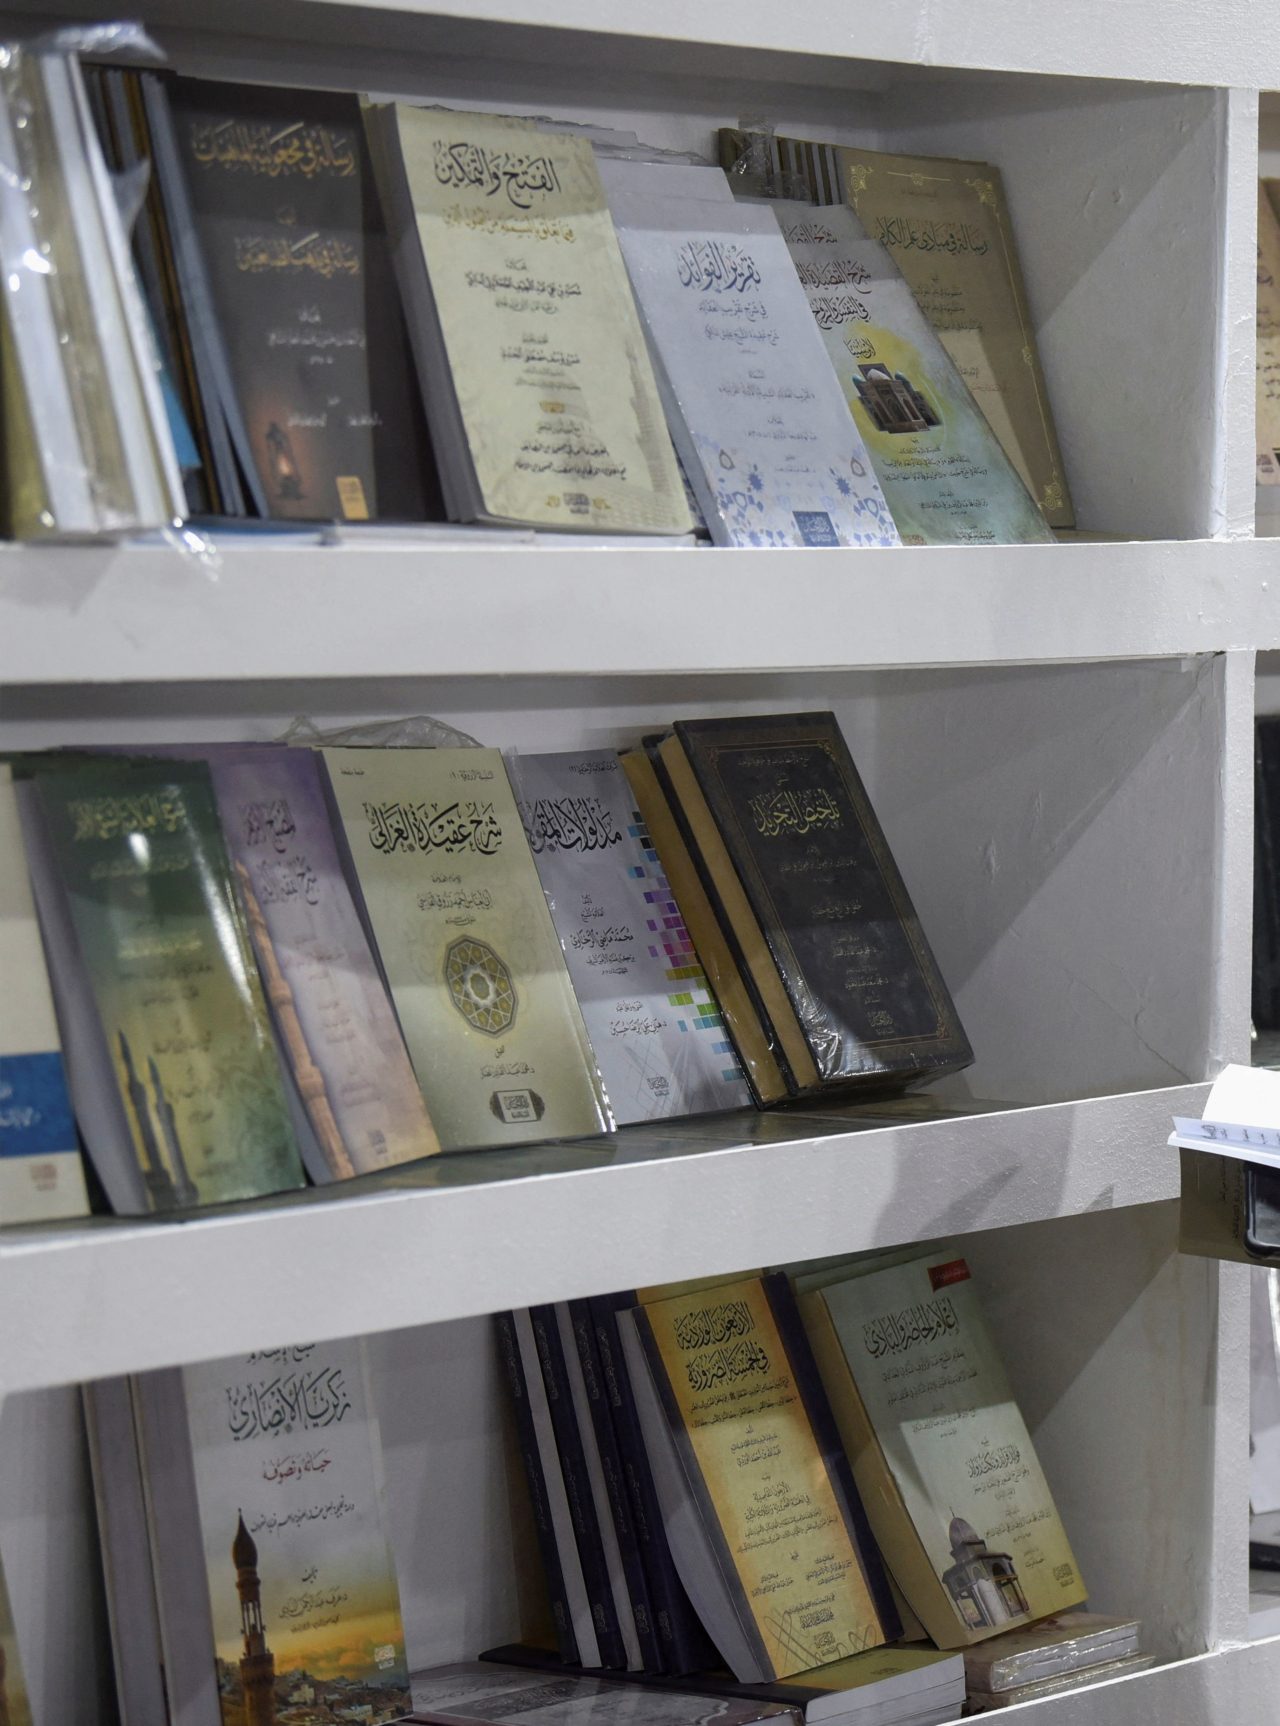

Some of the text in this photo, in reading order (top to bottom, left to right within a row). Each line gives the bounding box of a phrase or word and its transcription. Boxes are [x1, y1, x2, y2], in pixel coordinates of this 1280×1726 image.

[434, 140, 561, 209] الفتح والتمكين
[875, 216, 907, 248] الكلام
[958, 223, 989, 256] رسالة
[842, 259, 873, 294] شرح
[362, 801, 503, 856] شرح عقيدة الغزالي
[748, 788, 844, 836] تلخيص التجريد
[711, 1300, 756, 1344] الأربعون
[685, 1347, 733, 1393] الضرورية
[226, 1367, 352, 1442] زكريا الأنصاري
